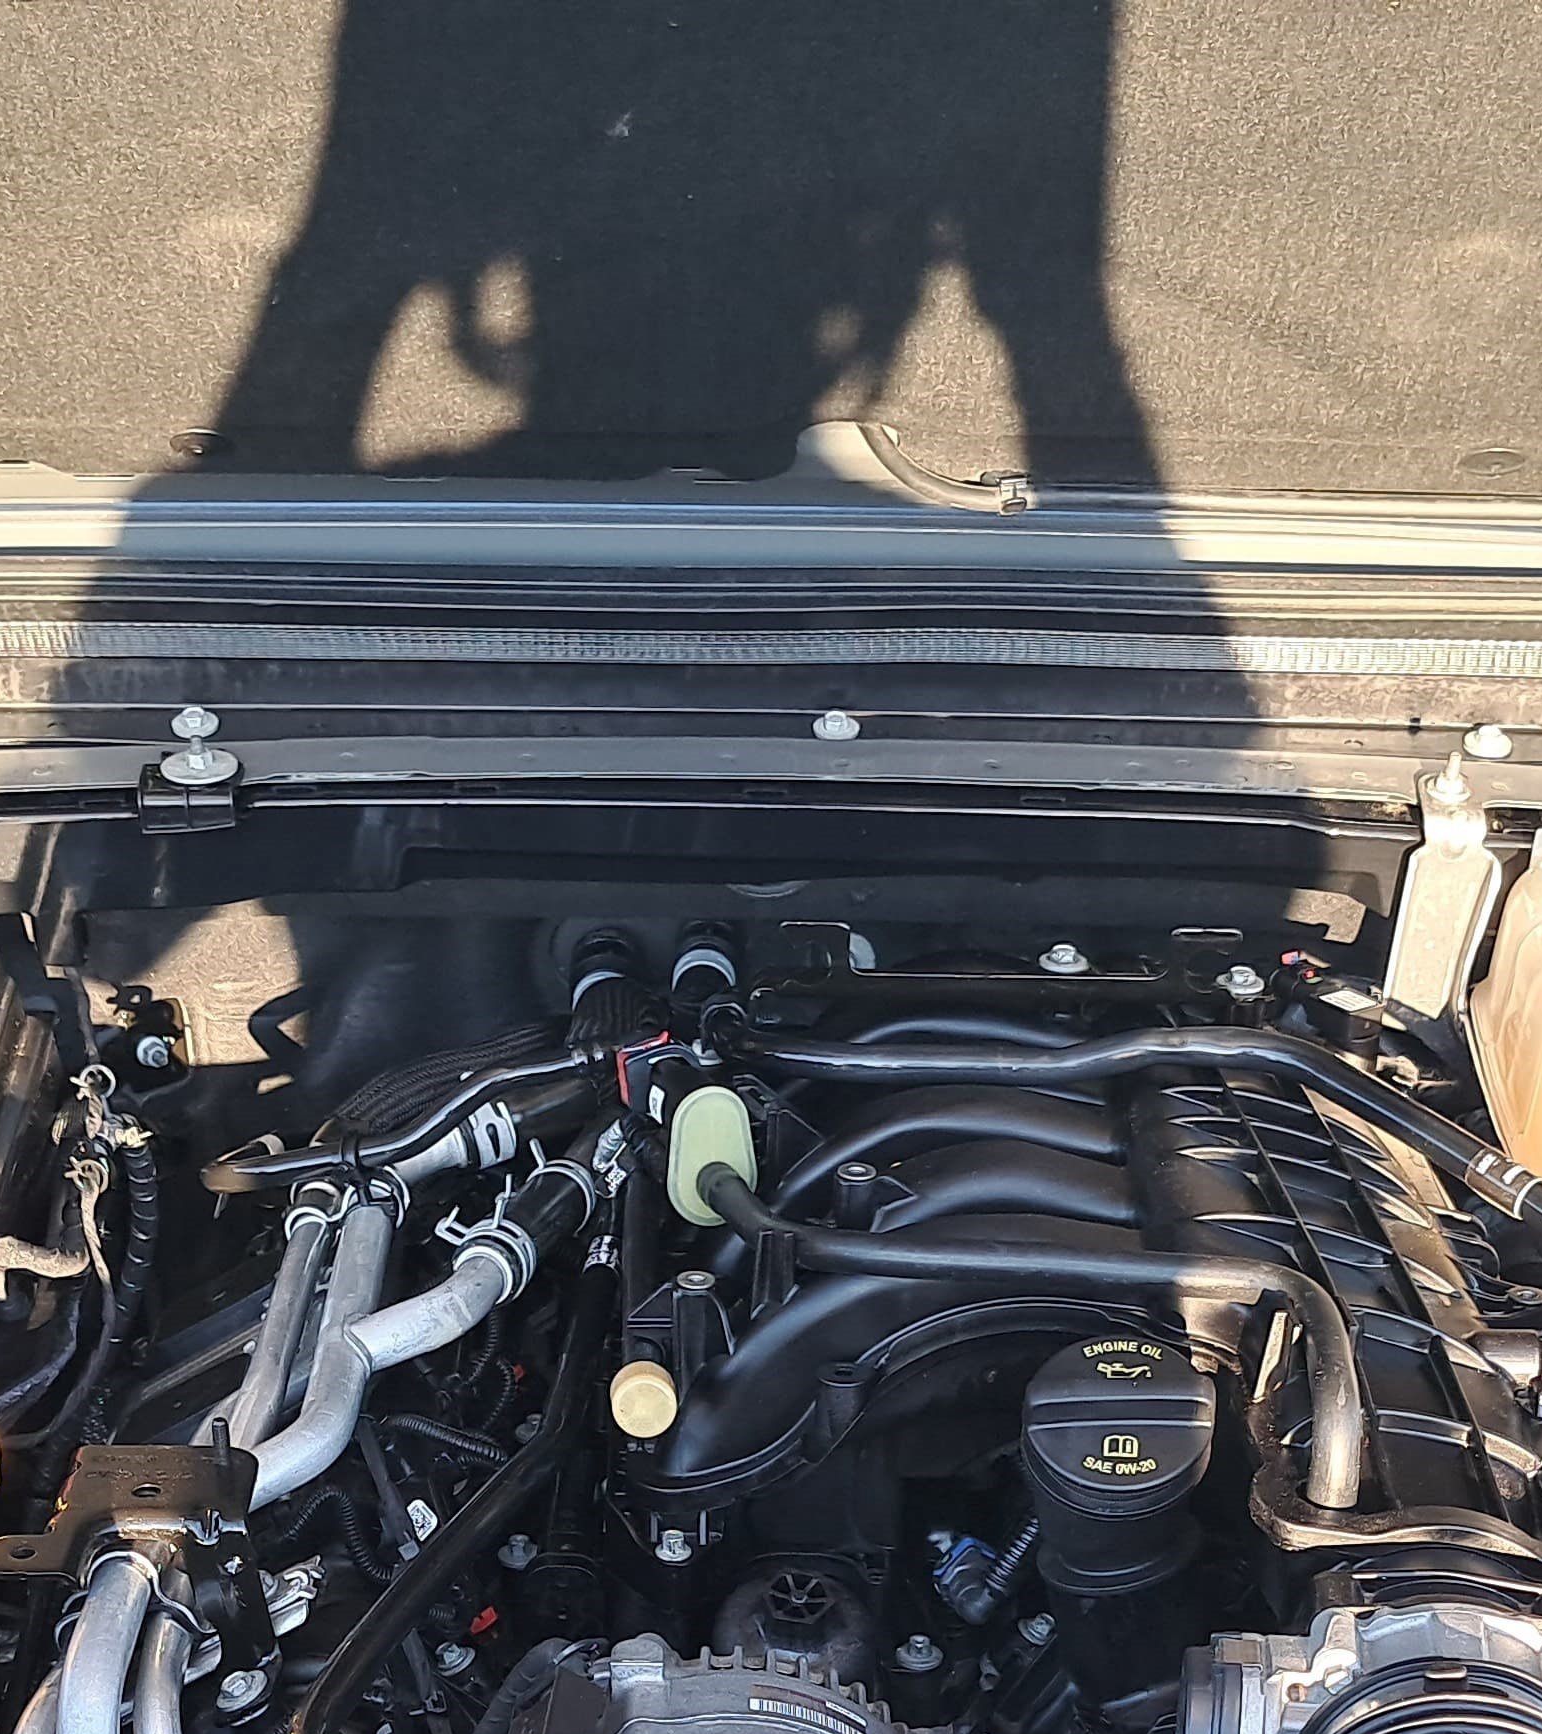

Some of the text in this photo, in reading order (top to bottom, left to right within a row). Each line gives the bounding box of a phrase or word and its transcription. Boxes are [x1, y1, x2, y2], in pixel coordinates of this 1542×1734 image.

[1082, 1341, 1164, 1360] ENGINE OIL
[1082, 1456, 1157, 1475] SAE 0W-20
